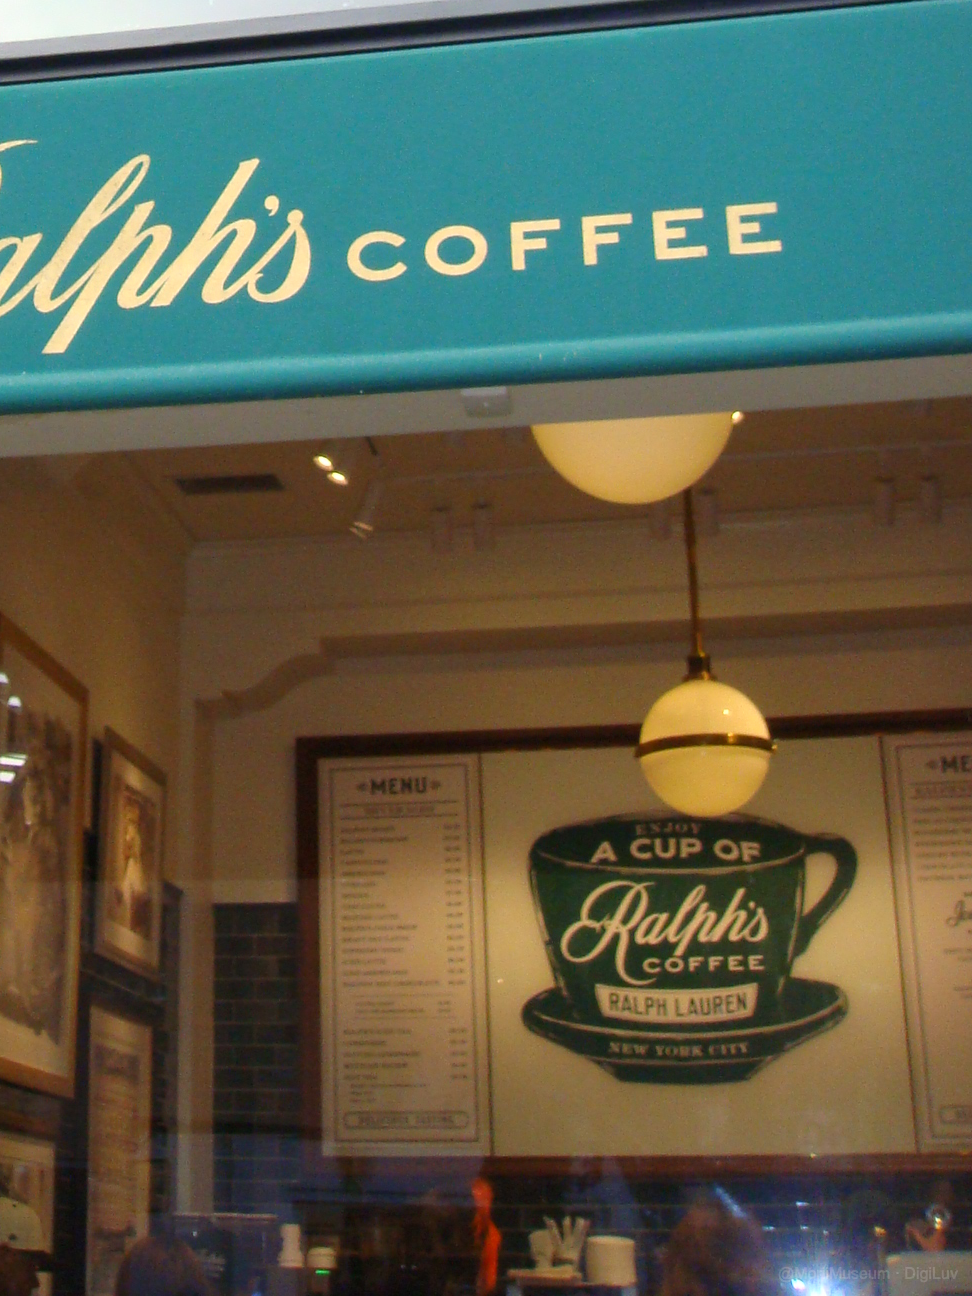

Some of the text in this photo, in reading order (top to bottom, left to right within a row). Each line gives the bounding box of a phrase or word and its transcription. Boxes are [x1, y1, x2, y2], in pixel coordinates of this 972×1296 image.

[347, 202, 782, 282] COFFEE
[370, 777, 427, 795] MENU
[635, 822, 702, 836] ENJOY
[590, 837, 761, 863] A CUP OF
[560, 880, 769, 986] Ralph's
[642, 955, 765, 973] COFFEE
[608, 992, 748, 1017] RALPH LAUREN
[608, 1041, 749, 1057] NEW YORK CITY
